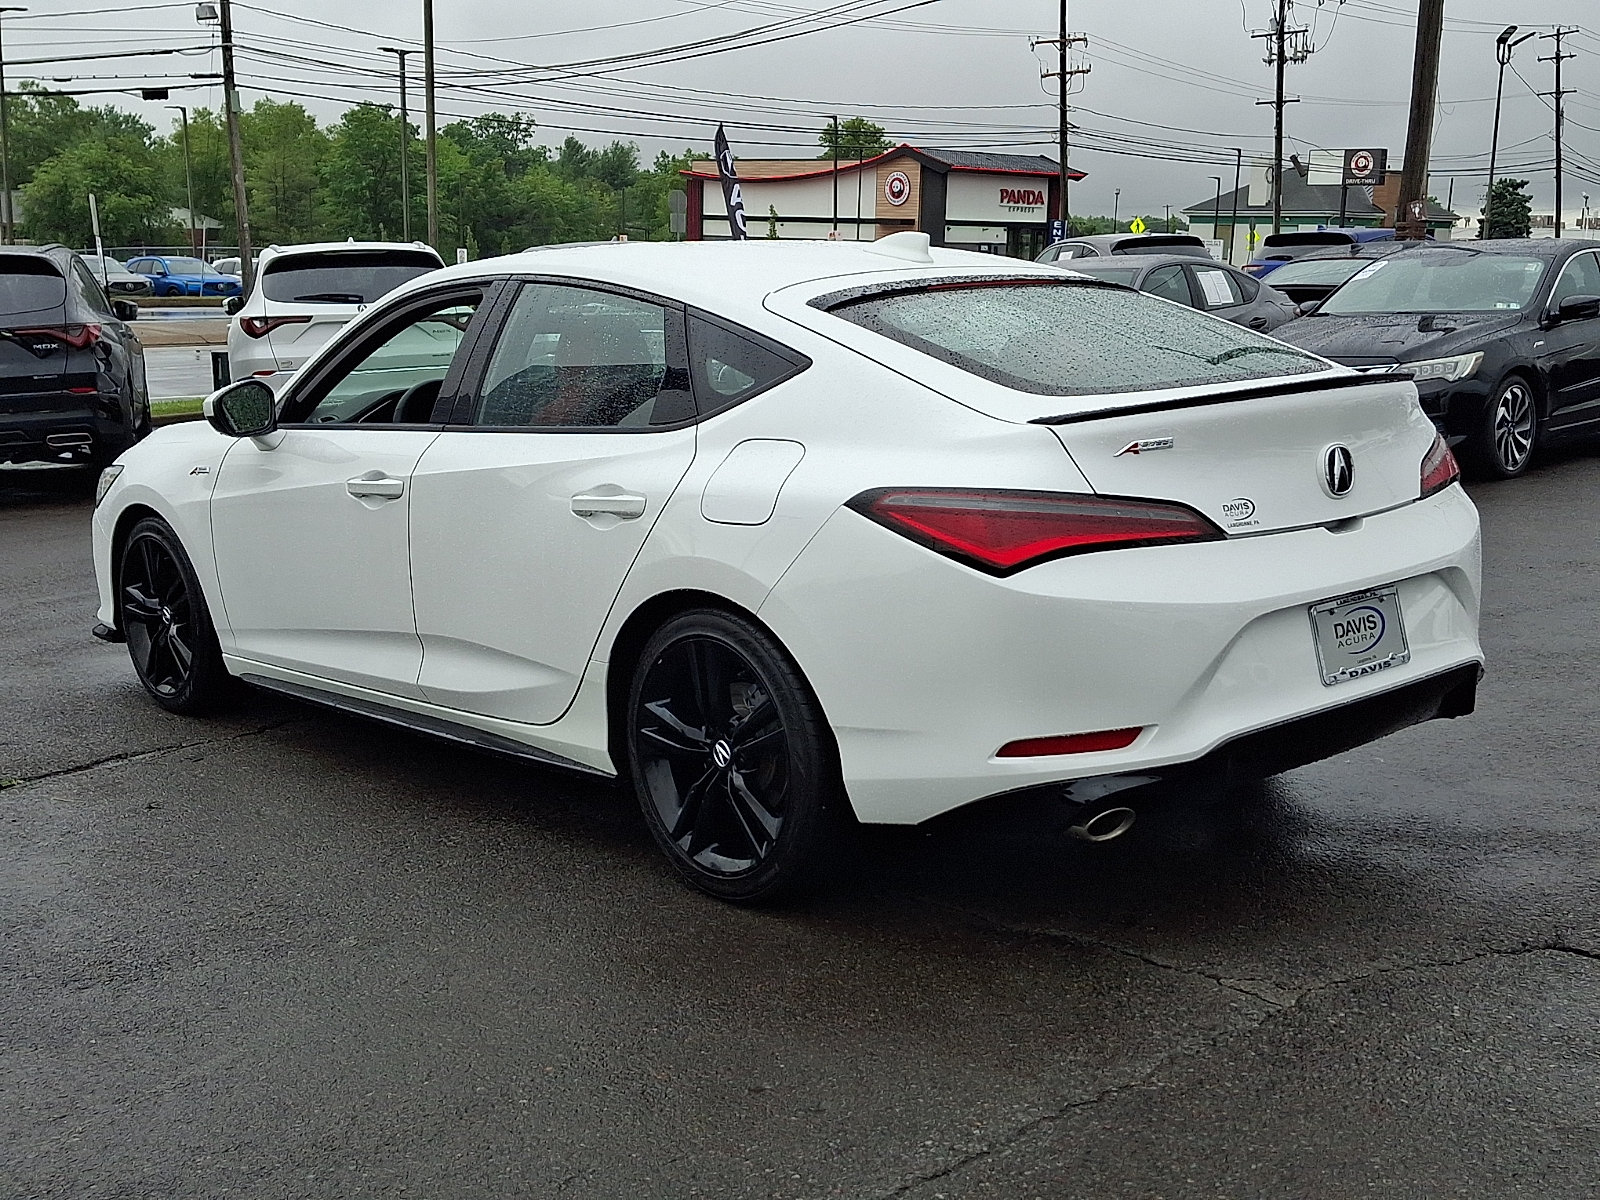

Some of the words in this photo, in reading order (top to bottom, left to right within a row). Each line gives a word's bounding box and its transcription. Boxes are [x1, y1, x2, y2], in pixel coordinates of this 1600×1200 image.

[1000, 188, 1045, 205] PANDA
[1222, 502, 1250, 512] DAVIS
[1333, 614, 1377, 639] DAVIS
[1337, 632, 1376, 648] ACURA
[1348, 660, 1392, 678] DAVIS
